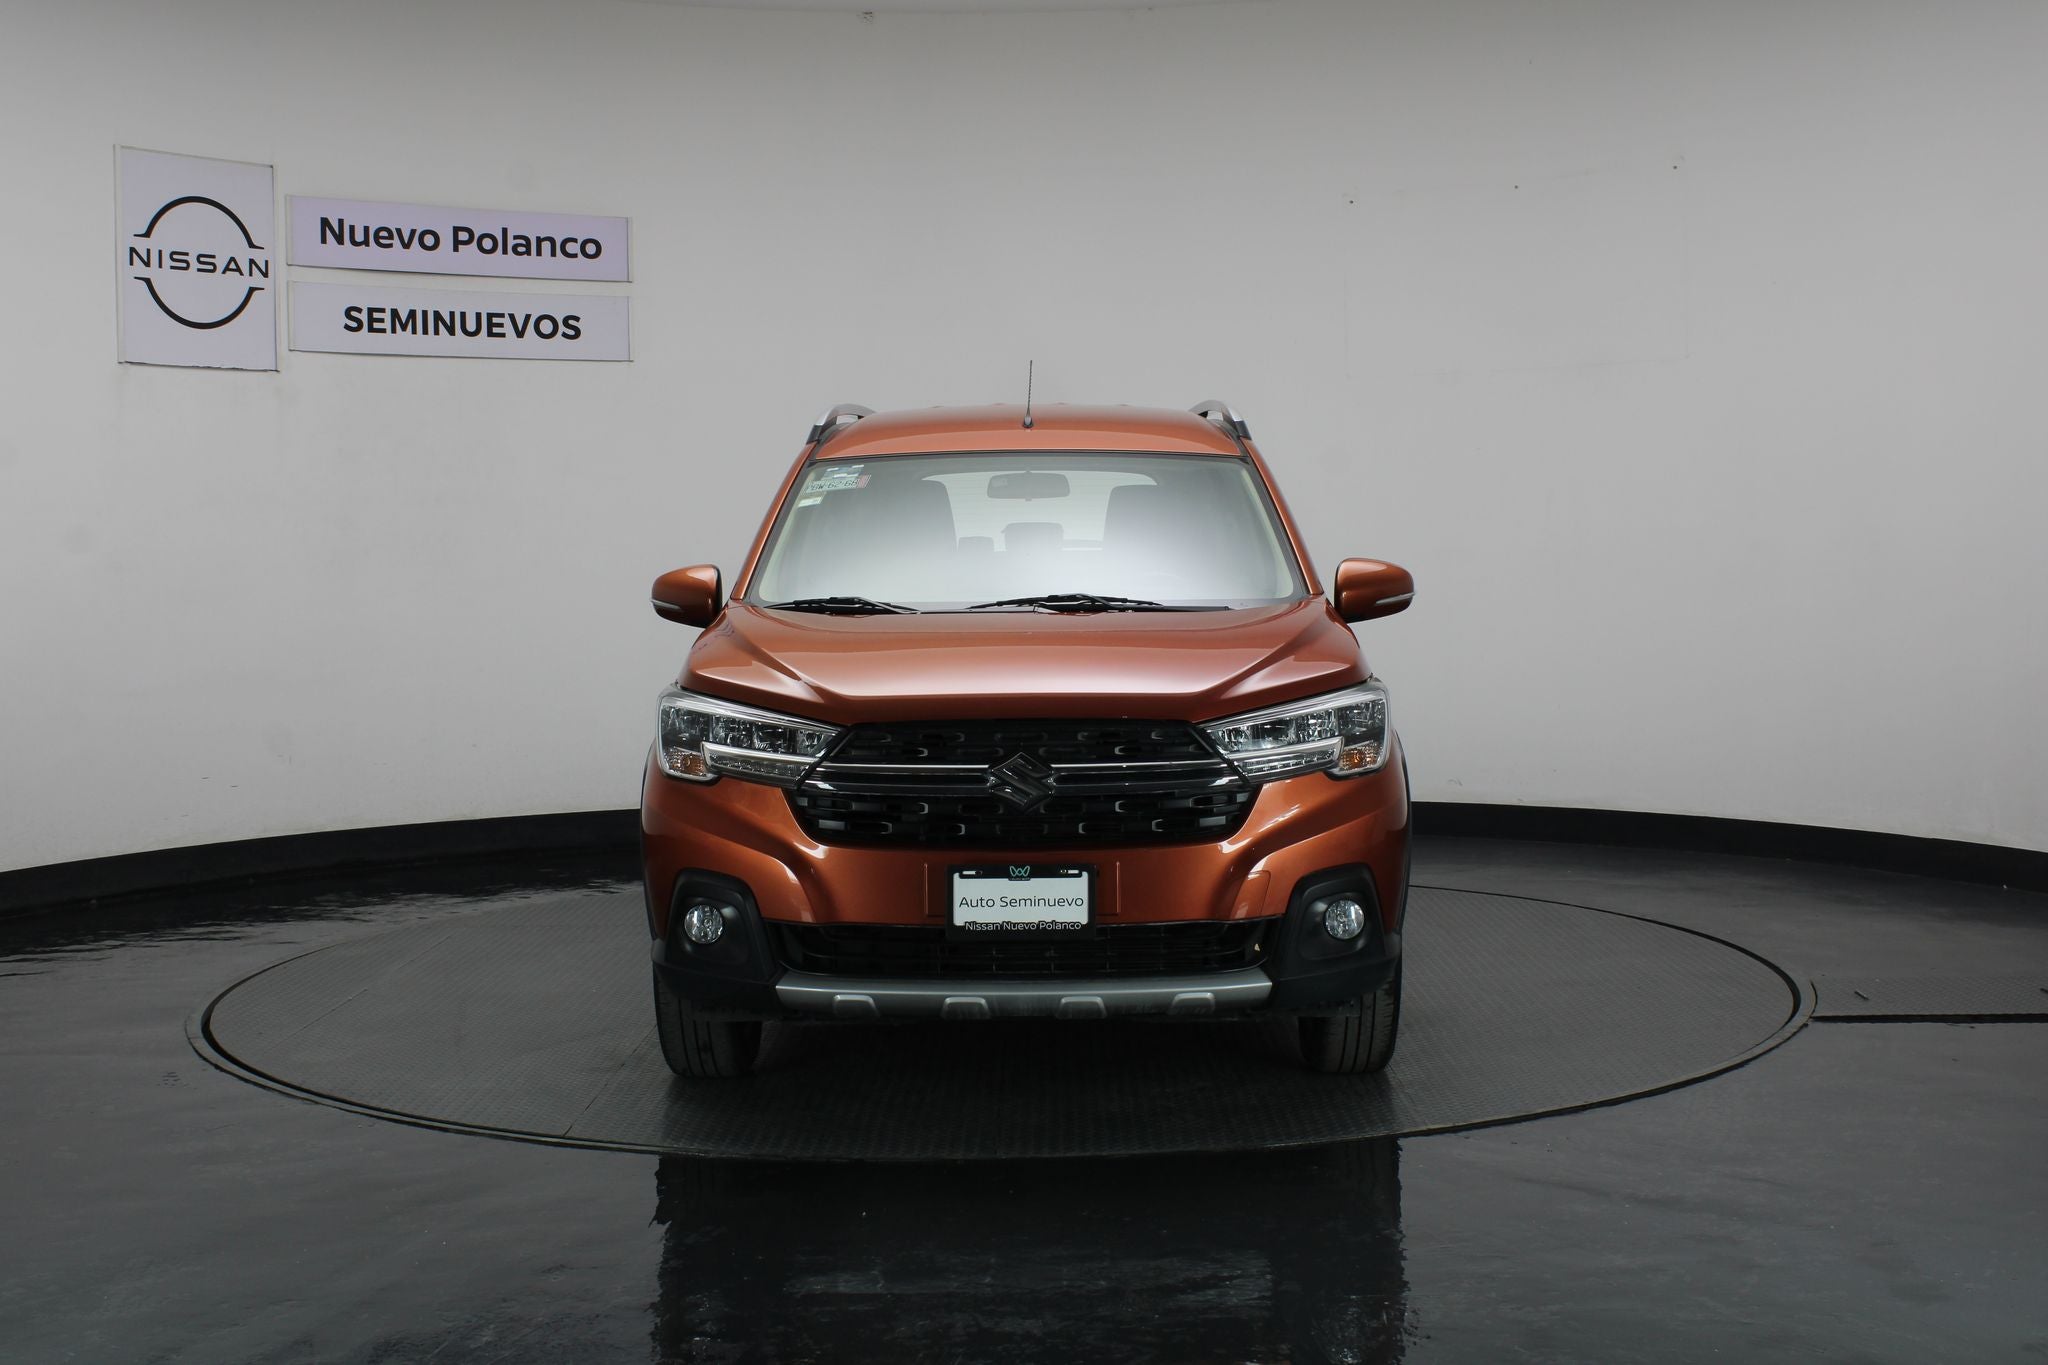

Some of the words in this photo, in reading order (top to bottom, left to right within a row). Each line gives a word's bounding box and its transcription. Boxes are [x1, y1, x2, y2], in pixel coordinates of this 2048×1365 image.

[319, 216, 441, 252] Nuevo
[452, 225, 603, 260] Polanco
[128, 246, 270, 279] NISSAN
[343, 305, 582, 341] SEMINUEVOS
[958, 896, 996, 908] Auto
[999, 895, 1084, 908] Seminuevo
[965, 921, 1001, 931] Nissan
[1003, 921, 1037, 931] Nuevo
[1039, 920, 1082, 930] Polanco
